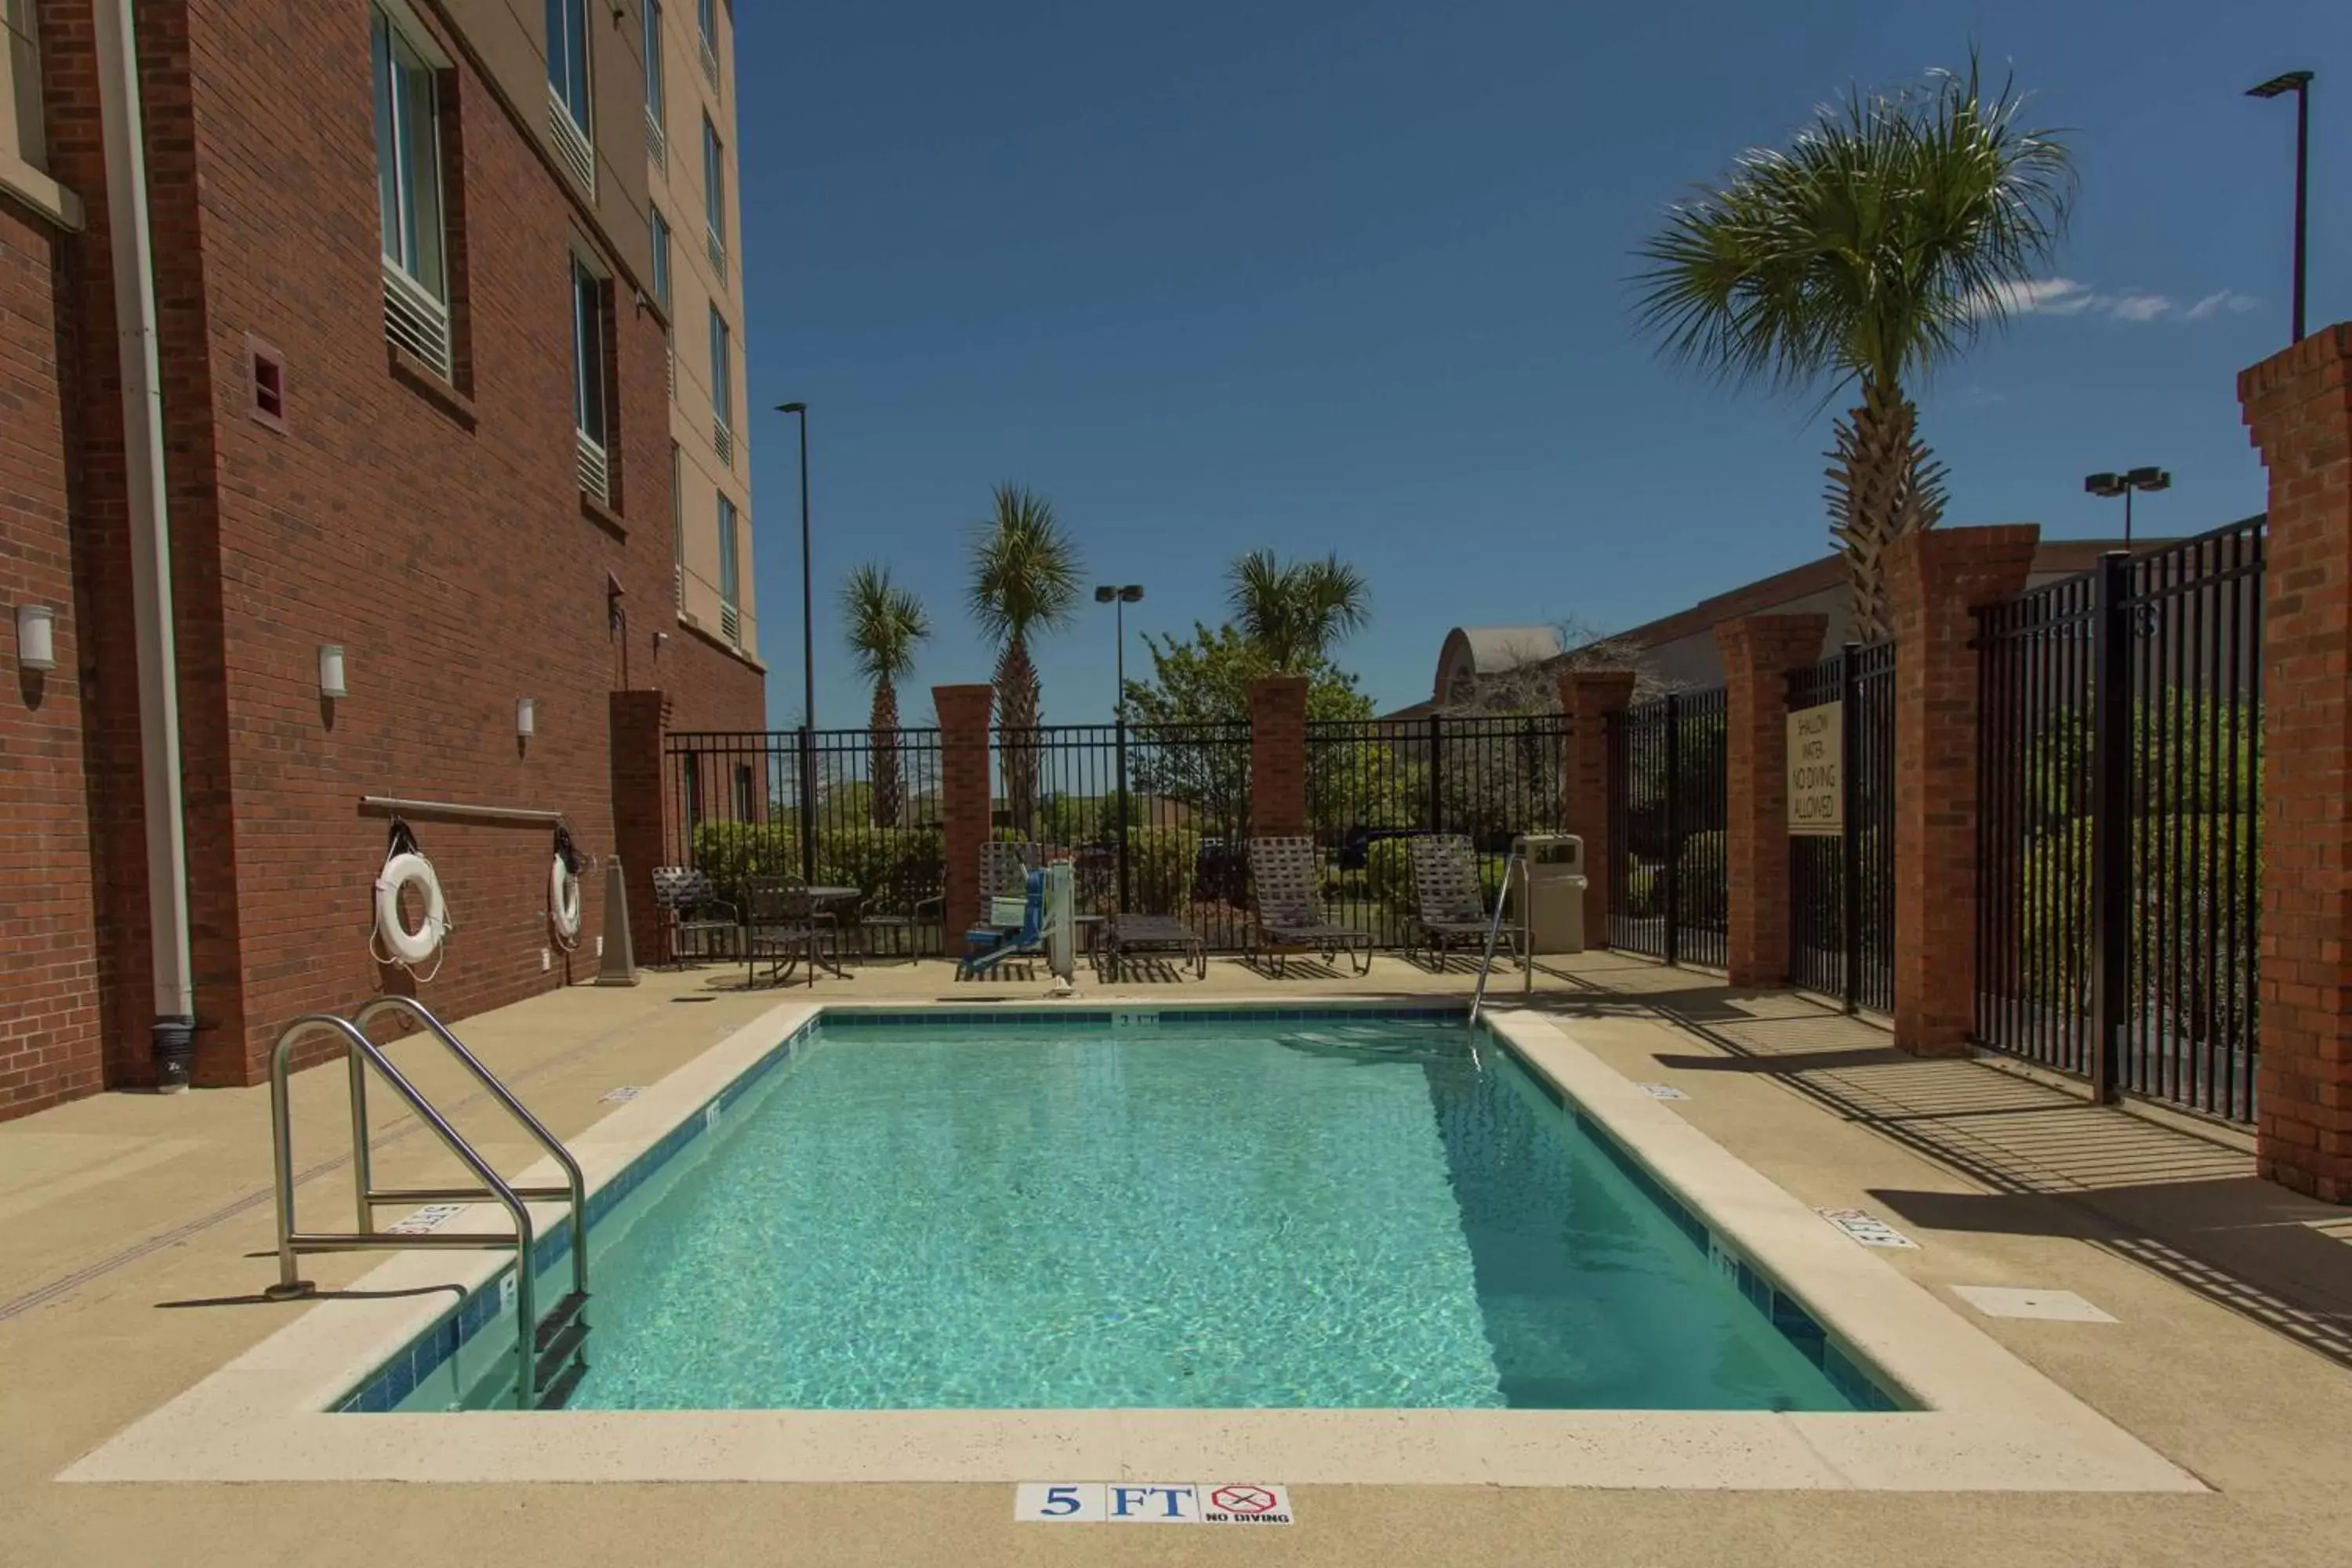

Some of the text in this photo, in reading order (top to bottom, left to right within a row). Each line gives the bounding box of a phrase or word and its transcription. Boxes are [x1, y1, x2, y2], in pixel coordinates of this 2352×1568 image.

[1797, 713, 1829, 737] SHALLOW
[1802, 740, 1825, 760] WATER
[1793, 764, 1835, 790] NO DIVING
[1795, 795, 1833, 818] ALLOWED
[1040, 1486, 1290, 1523] 5 FT NO DIVING
